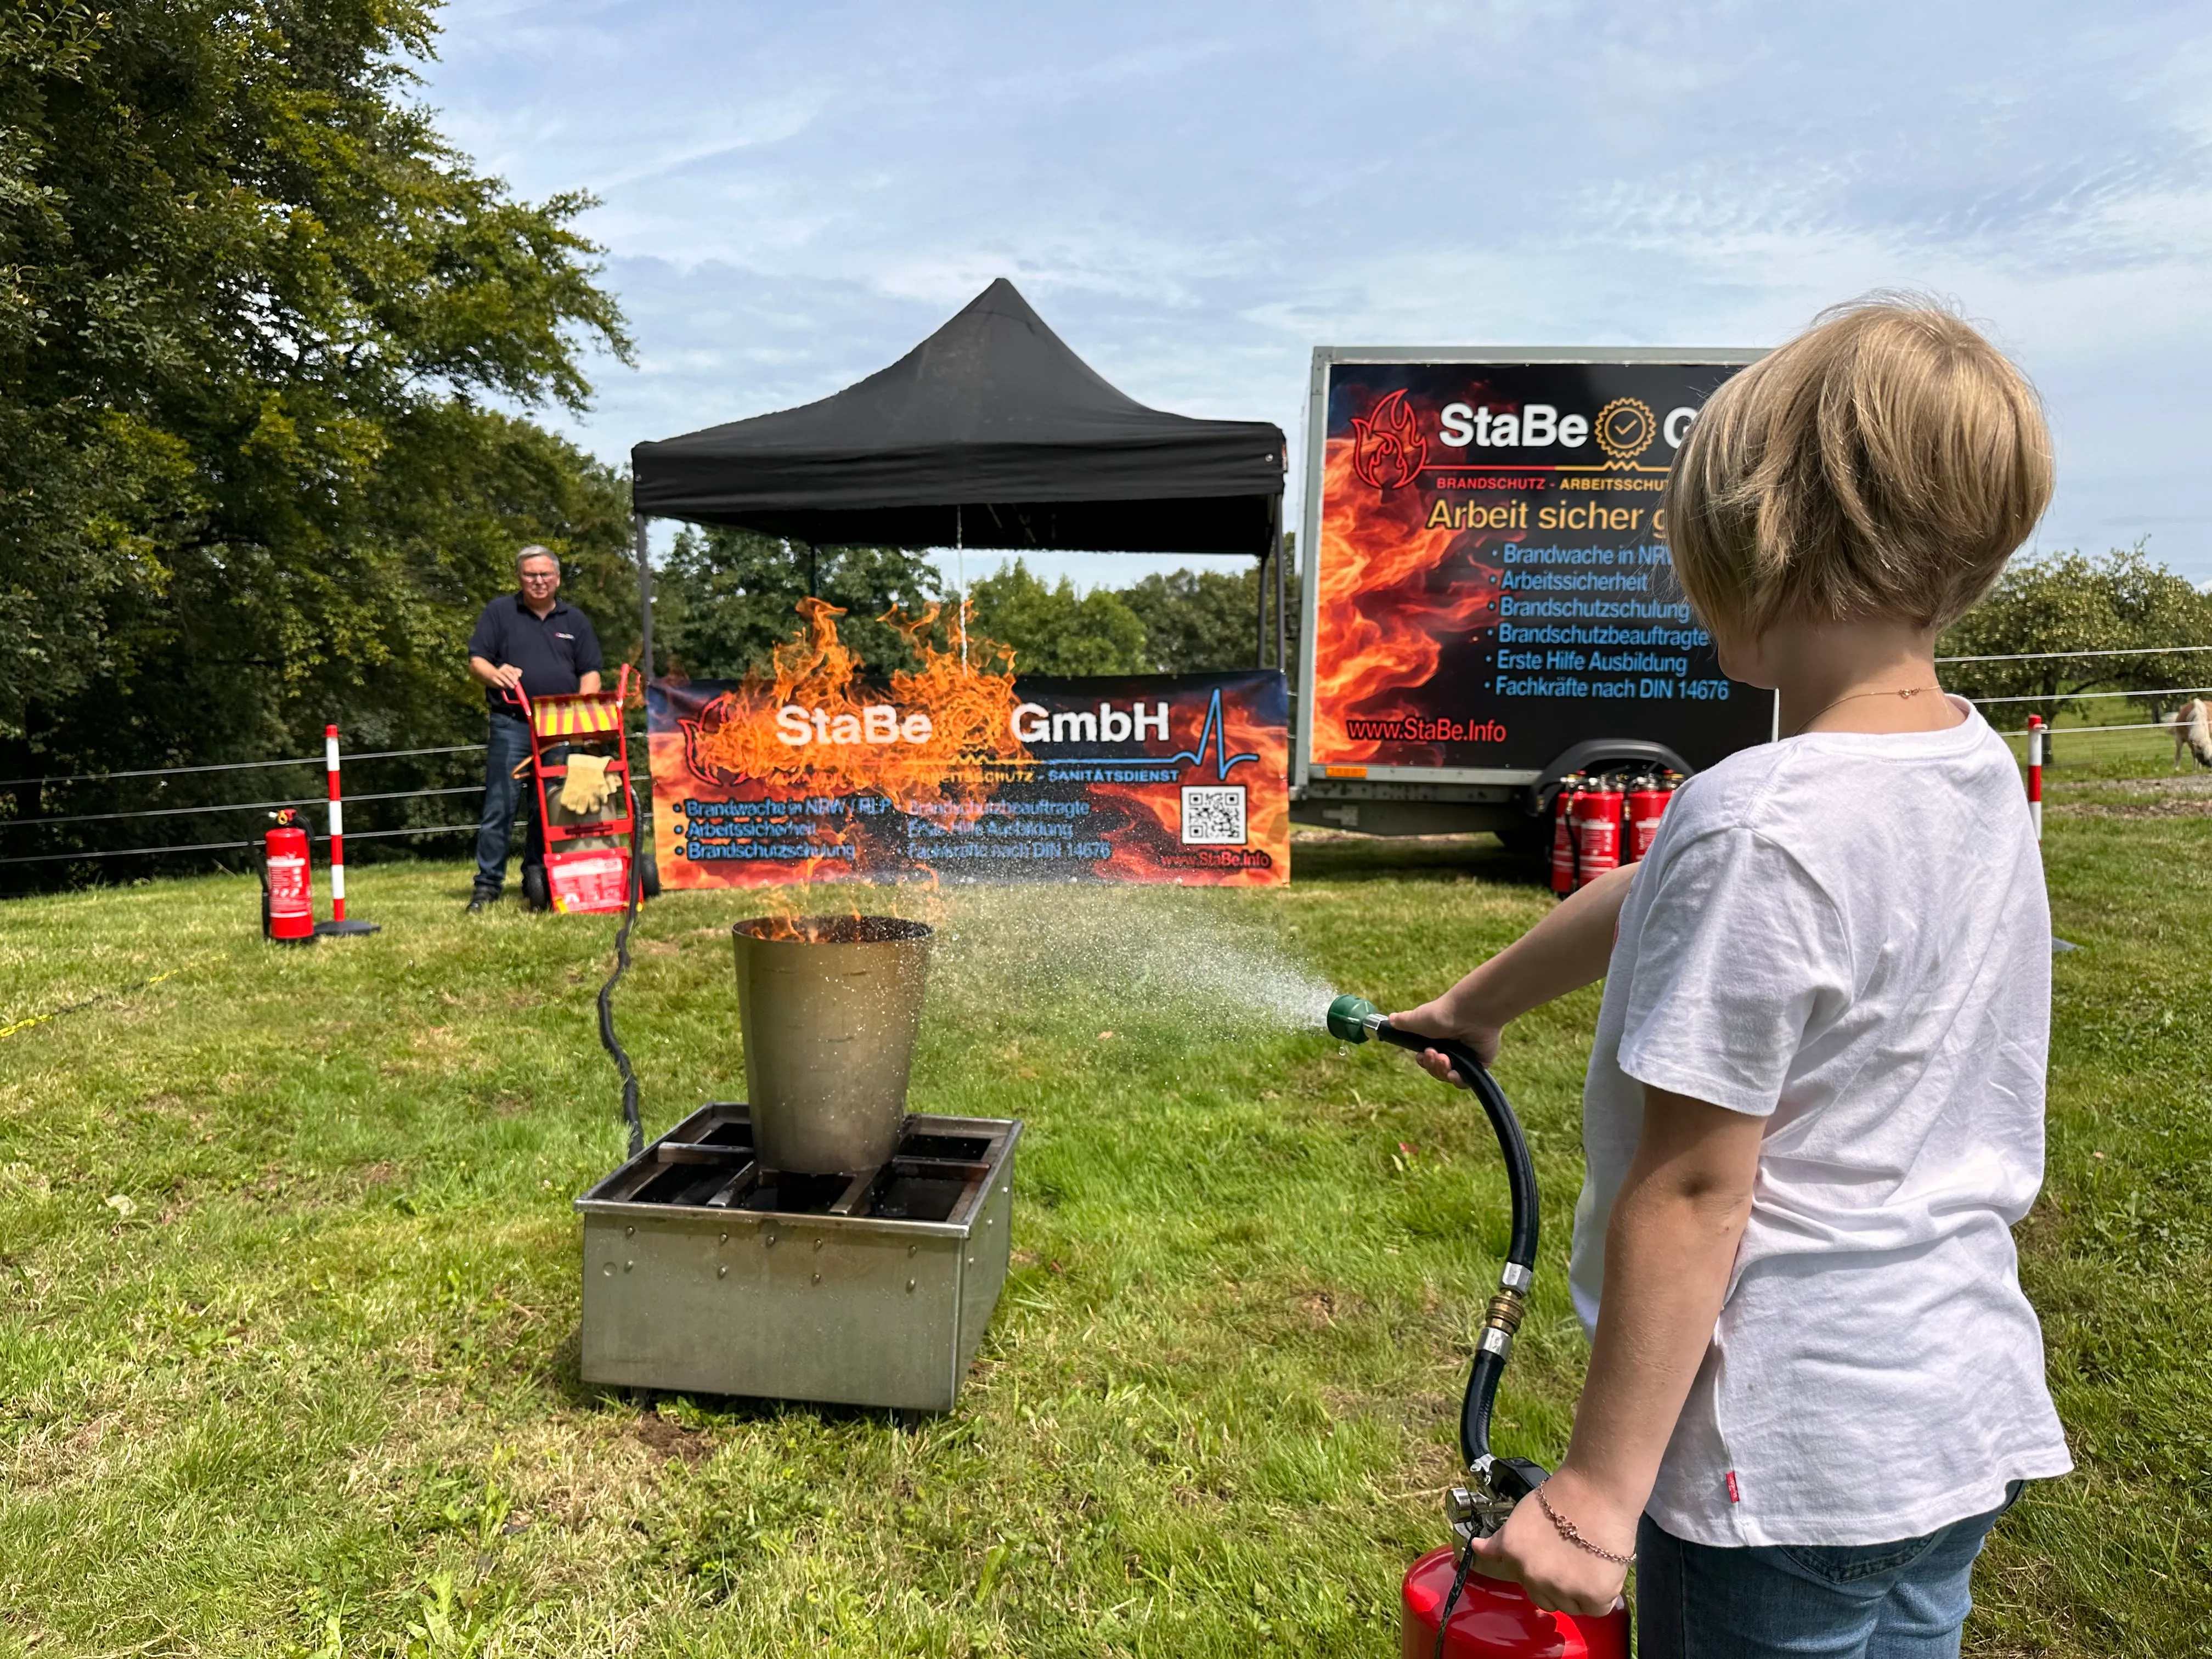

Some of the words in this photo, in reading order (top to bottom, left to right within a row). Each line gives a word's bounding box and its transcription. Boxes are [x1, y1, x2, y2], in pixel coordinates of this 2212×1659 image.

[1439, 402, 1589, 448] StaBe
[1436, 477, 1546, 490] BRANDSCHUTZ
[1427, 499, 1530, 529] Arbeit
[1538, 500, 1645, 530] sicher
[1503, 543, 1614, 565] Brandwache
[1618, 544, 1633, 565] in
[1500, 569, 1648, 591] Arbeitssicherheit
[1500, 595, 1690, 624] Brandschutzschulung
[1498, 623, 1709, 651] Brandschutzbeauftragte
[1497, 649, 1543, 670] Erste
[1546, 650, 1586, 670] Hilfe
[1588, 651, 1688, 677] Ausbildung
[1495, 675, 1589, 697] Fachkräfte
[1592, 677, 1636, 698] nach
[1639, 678, 1673, 699] DIN
[1678, 679, 1730, 701] 14676
[776, 704, 933, 746] StaBe
[1010, 702, 1170, 743] GmbH
[1348, 717, 1506, 742] www.StaBe.Info
[1048, 769, 1180, 782] SANITÄTSDIENST
[686, 799, 786, 816] Brandwache
[787, 799, 802, 816] in
[805, 798, 846, 815] NRW
[858, 798, 892, 814] RLP
[688, 821, 816, 838] Arbeitssicherheit
[688, 841, 856, 861] Brandschutzschulung
[1033, 842, 1062, 857] DIN
[1067, 842, 1112, 859] 14676
[1161, 850, 1269, 867] www.StaBe.Info
